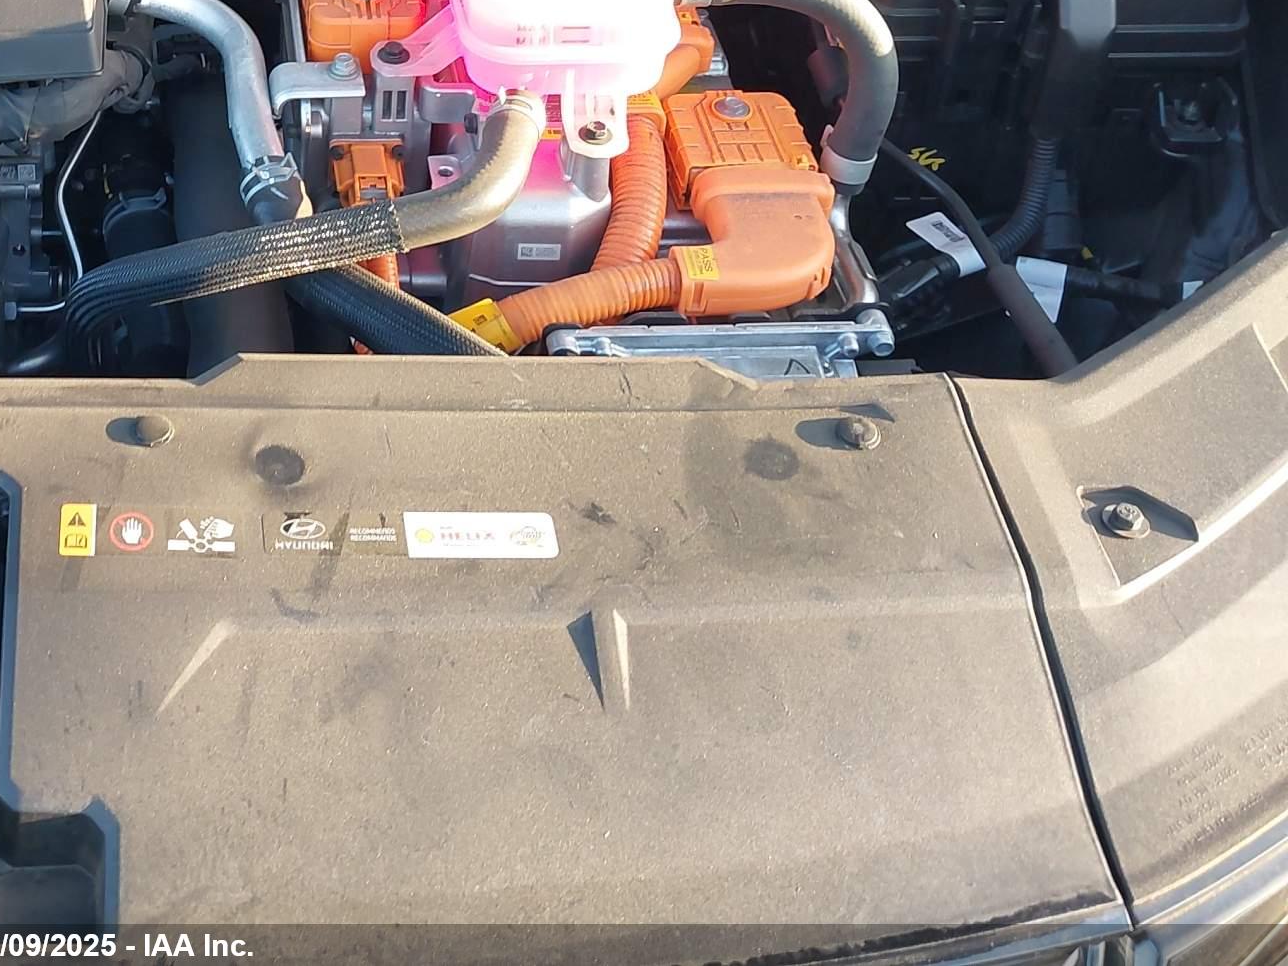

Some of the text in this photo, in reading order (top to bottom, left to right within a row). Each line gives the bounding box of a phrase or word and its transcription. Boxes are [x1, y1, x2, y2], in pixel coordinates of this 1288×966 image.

[701, 247, 713, 272] PASS
[440, 532, 496, 540] HELIX
[274, 539, 334, 551] HYUNDAI
